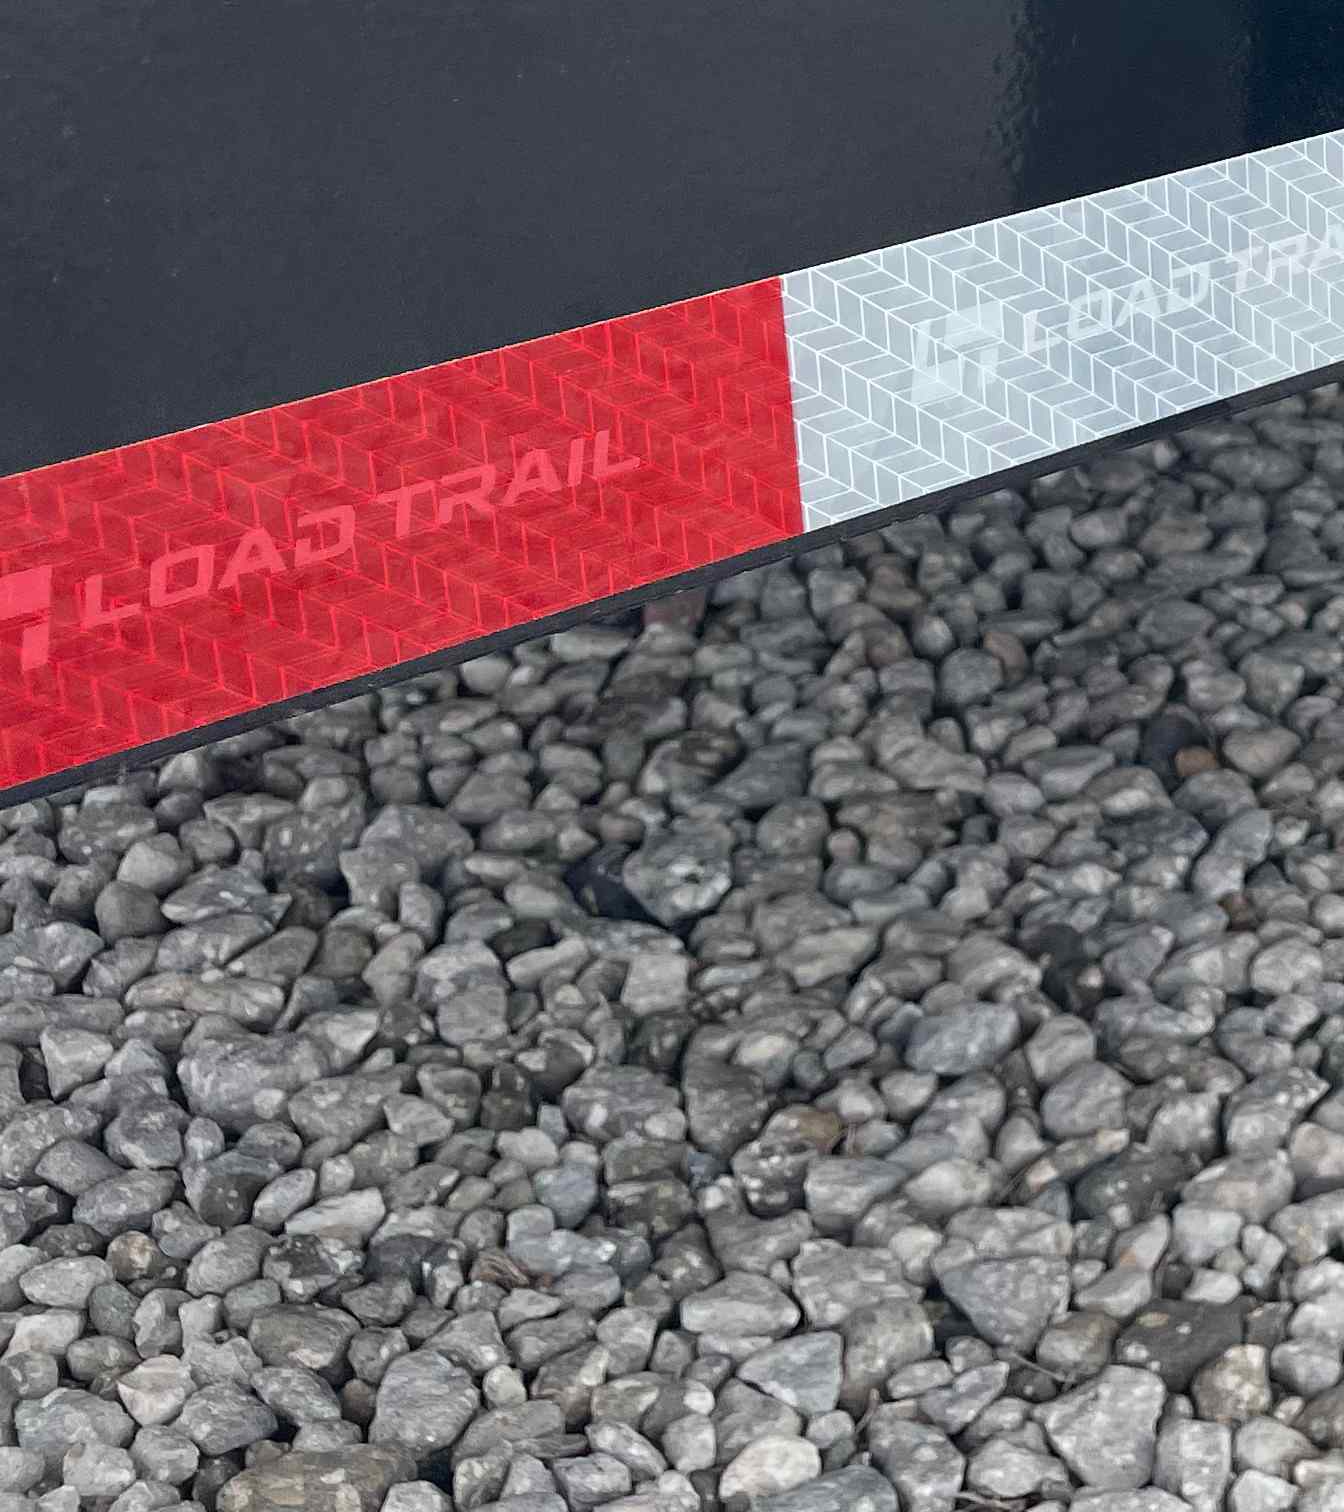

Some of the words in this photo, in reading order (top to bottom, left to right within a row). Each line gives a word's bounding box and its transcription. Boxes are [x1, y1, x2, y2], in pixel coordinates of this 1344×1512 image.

[1023, 261, 1211, 354] LOAD
[82, 505, 355, 629] LOAD
[378, 430, 641, 537] TRAIL
